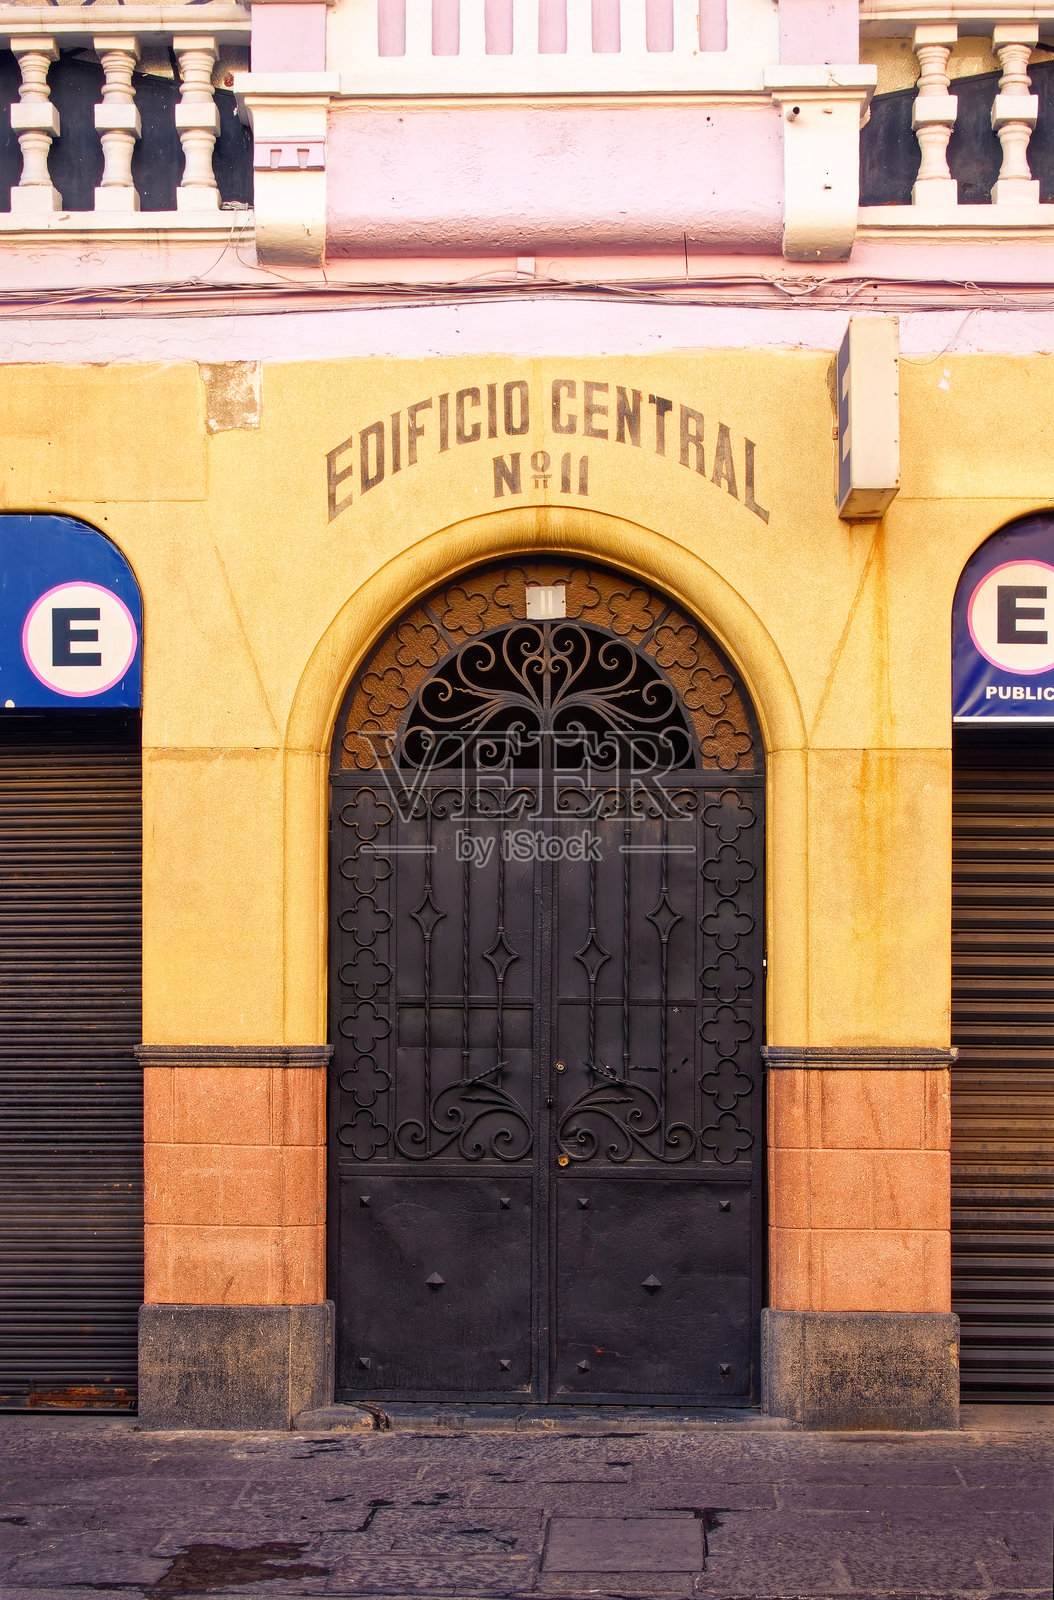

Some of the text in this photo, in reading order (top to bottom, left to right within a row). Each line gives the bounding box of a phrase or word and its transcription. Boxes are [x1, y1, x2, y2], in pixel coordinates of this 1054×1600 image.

[325, 380, 529, 524] EDIFICIO
[551, 379, 769, 525] CENTRAL
[52, 607, 101, 666] E
[997, 585, 1048, 644] E
[985, 686, 1054, 700] PUBLIC
